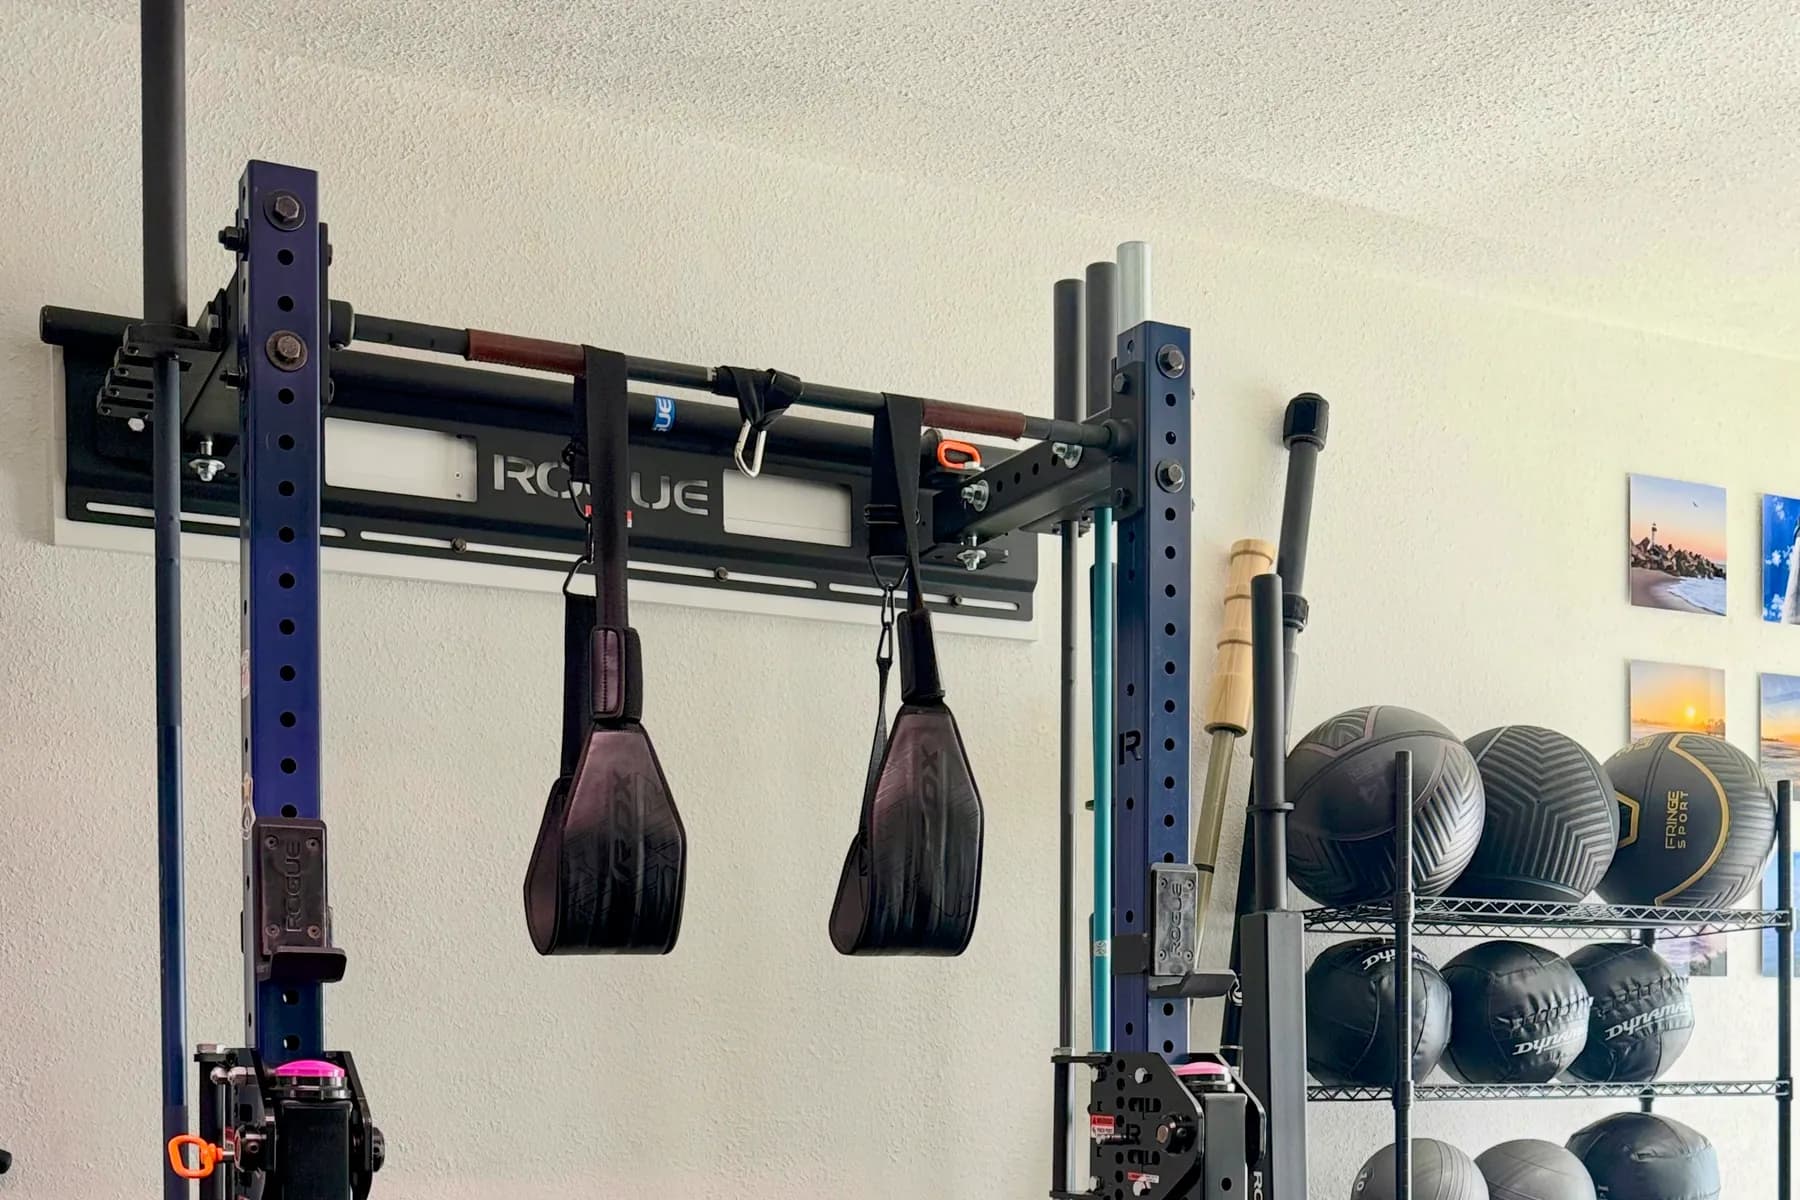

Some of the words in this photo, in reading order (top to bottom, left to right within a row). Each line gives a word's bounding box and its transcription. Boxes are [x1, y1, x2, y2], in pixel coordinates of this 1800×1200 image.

[493, 453, 709, 516] ROUE
[1665, 790, 1681, 849] FRINGE
[1677, 790, 1690, 849] SPORT
[285, 839, 302, 932] ROGUE
[1170, 881, 1184, 957] ROGUE
